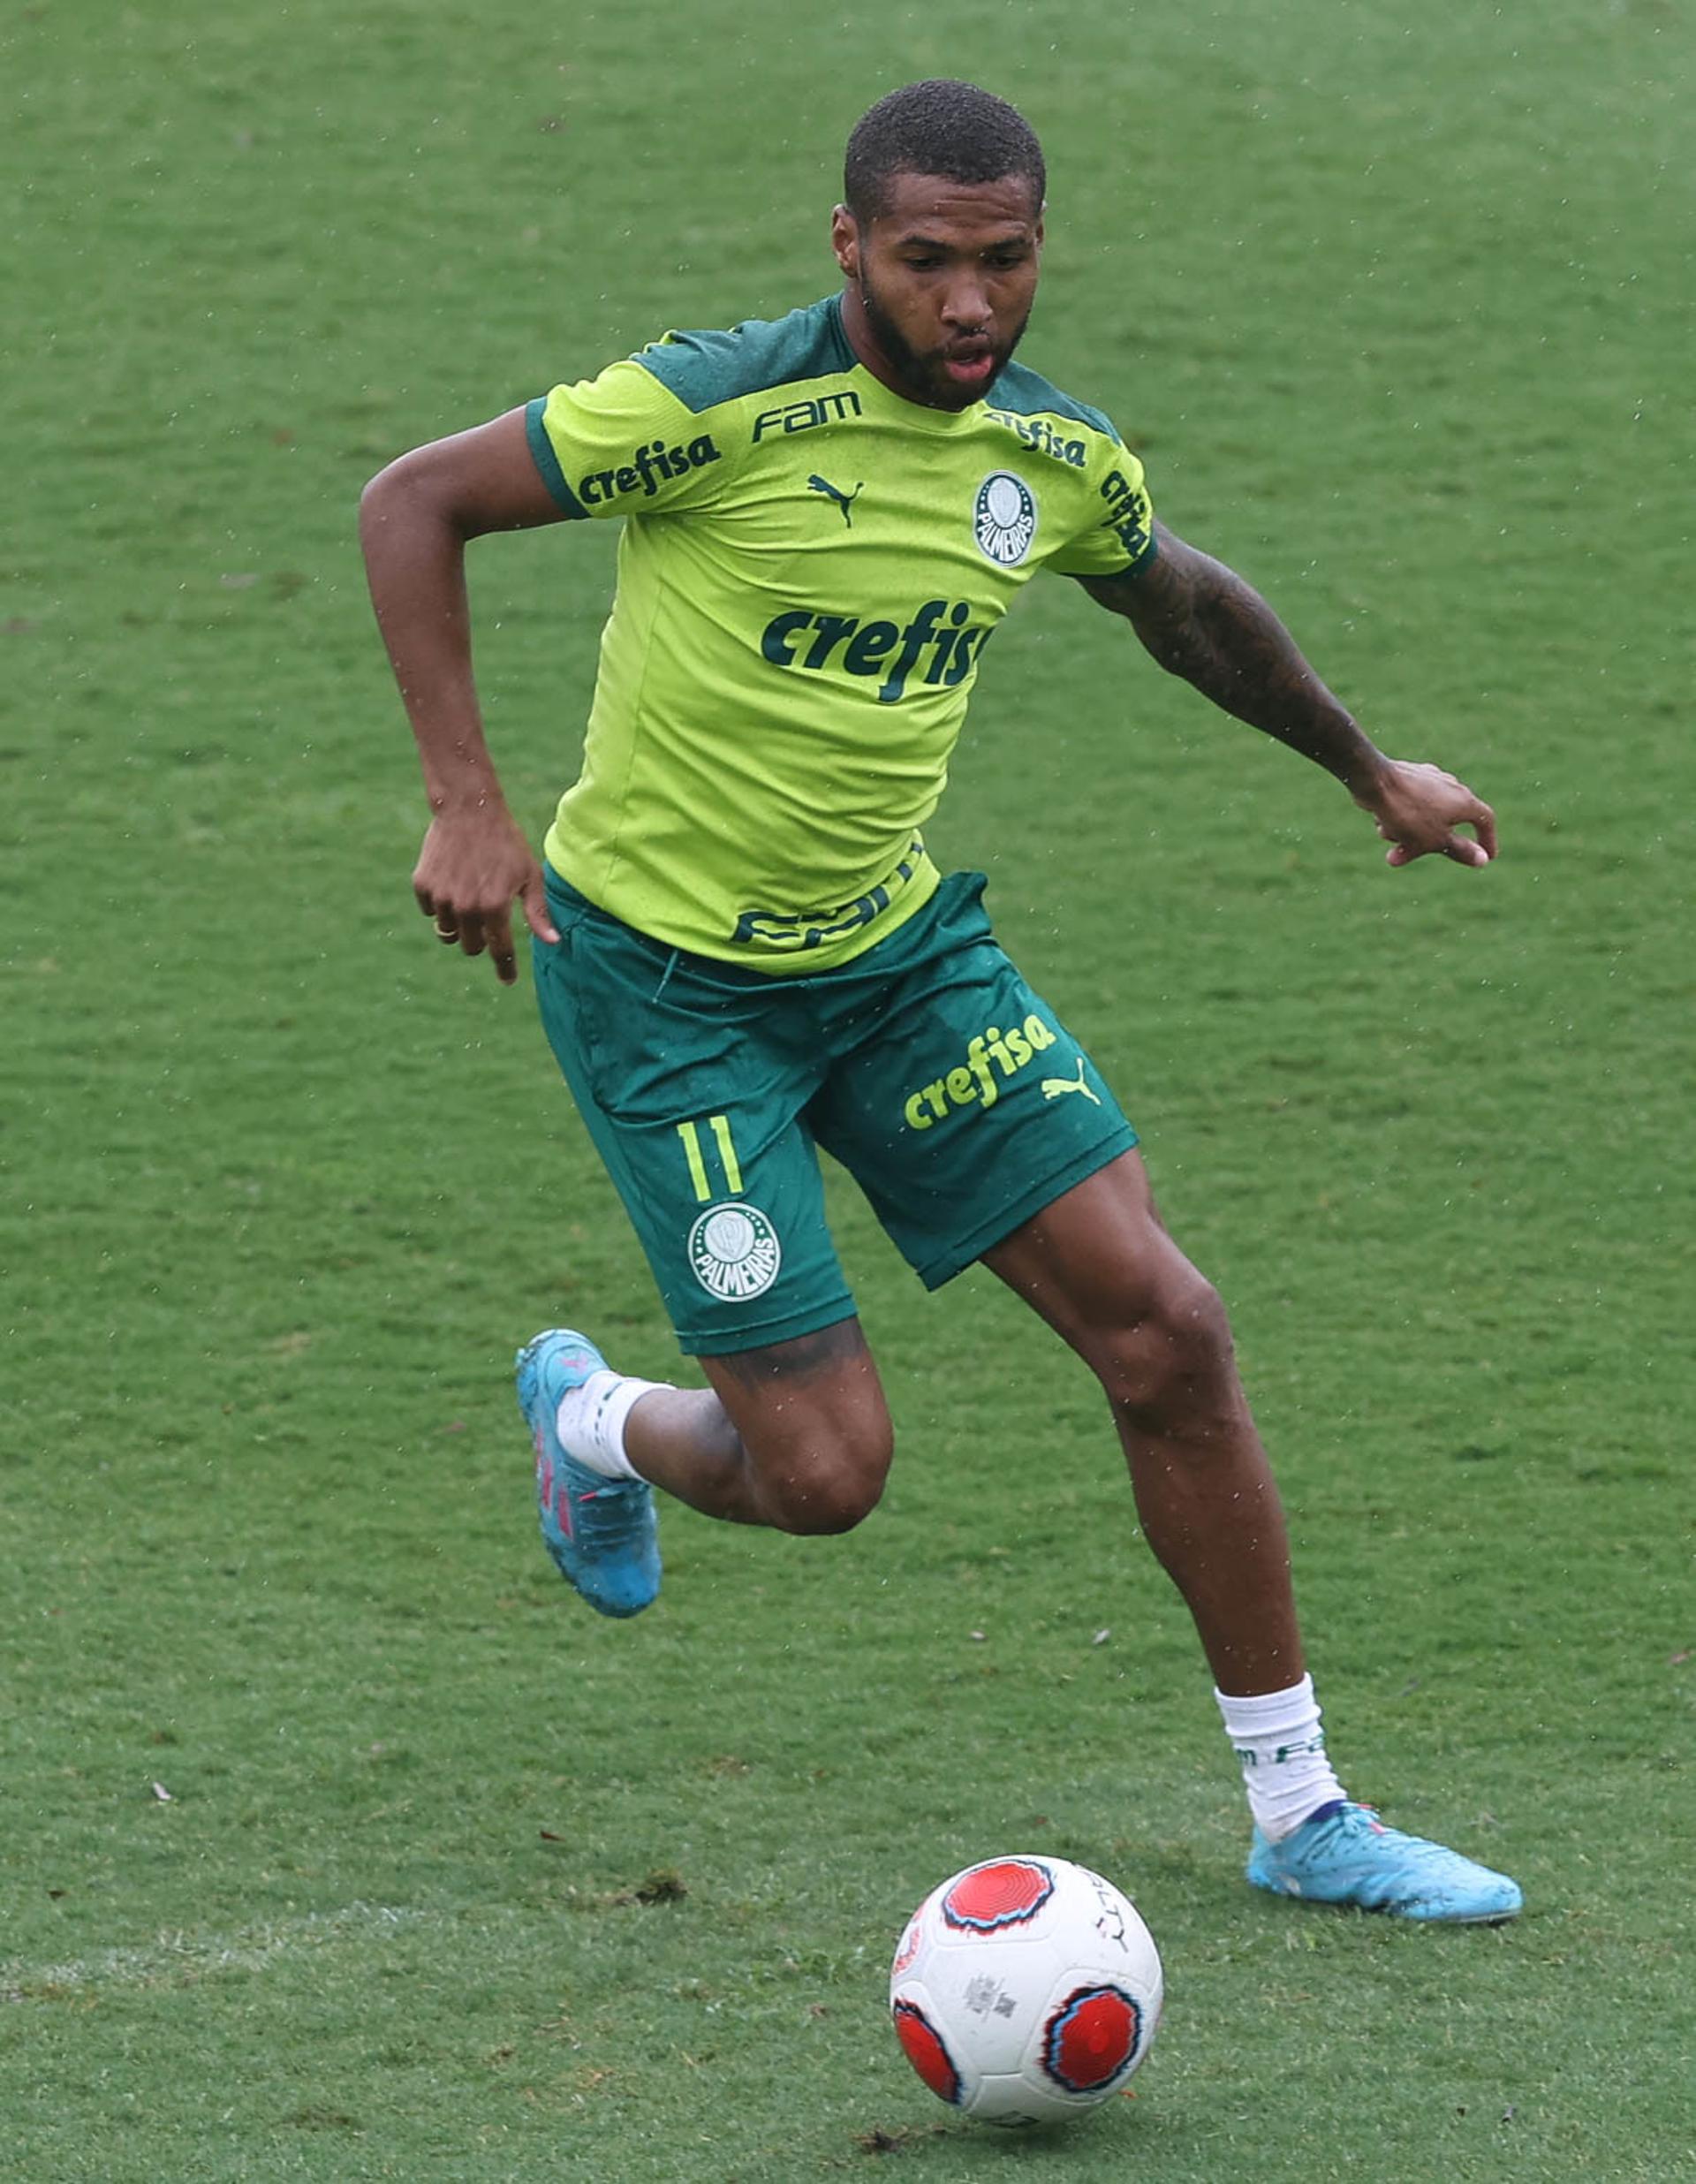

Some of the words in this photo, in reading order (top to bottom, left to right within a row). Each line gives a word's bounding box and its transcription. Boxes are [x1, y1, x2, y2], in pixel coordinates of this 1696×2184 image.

[579, 434, 721, 504] crefisa
[977, 512, 1033, 561] PALMEIRAS
[761, 600, 996, 702] crefis
[905, 1014, 1056, 1129] crefisa
[677, 1115, 744, 1202] 11
[695, 1237, 775, 1295] PALMEIRAS
